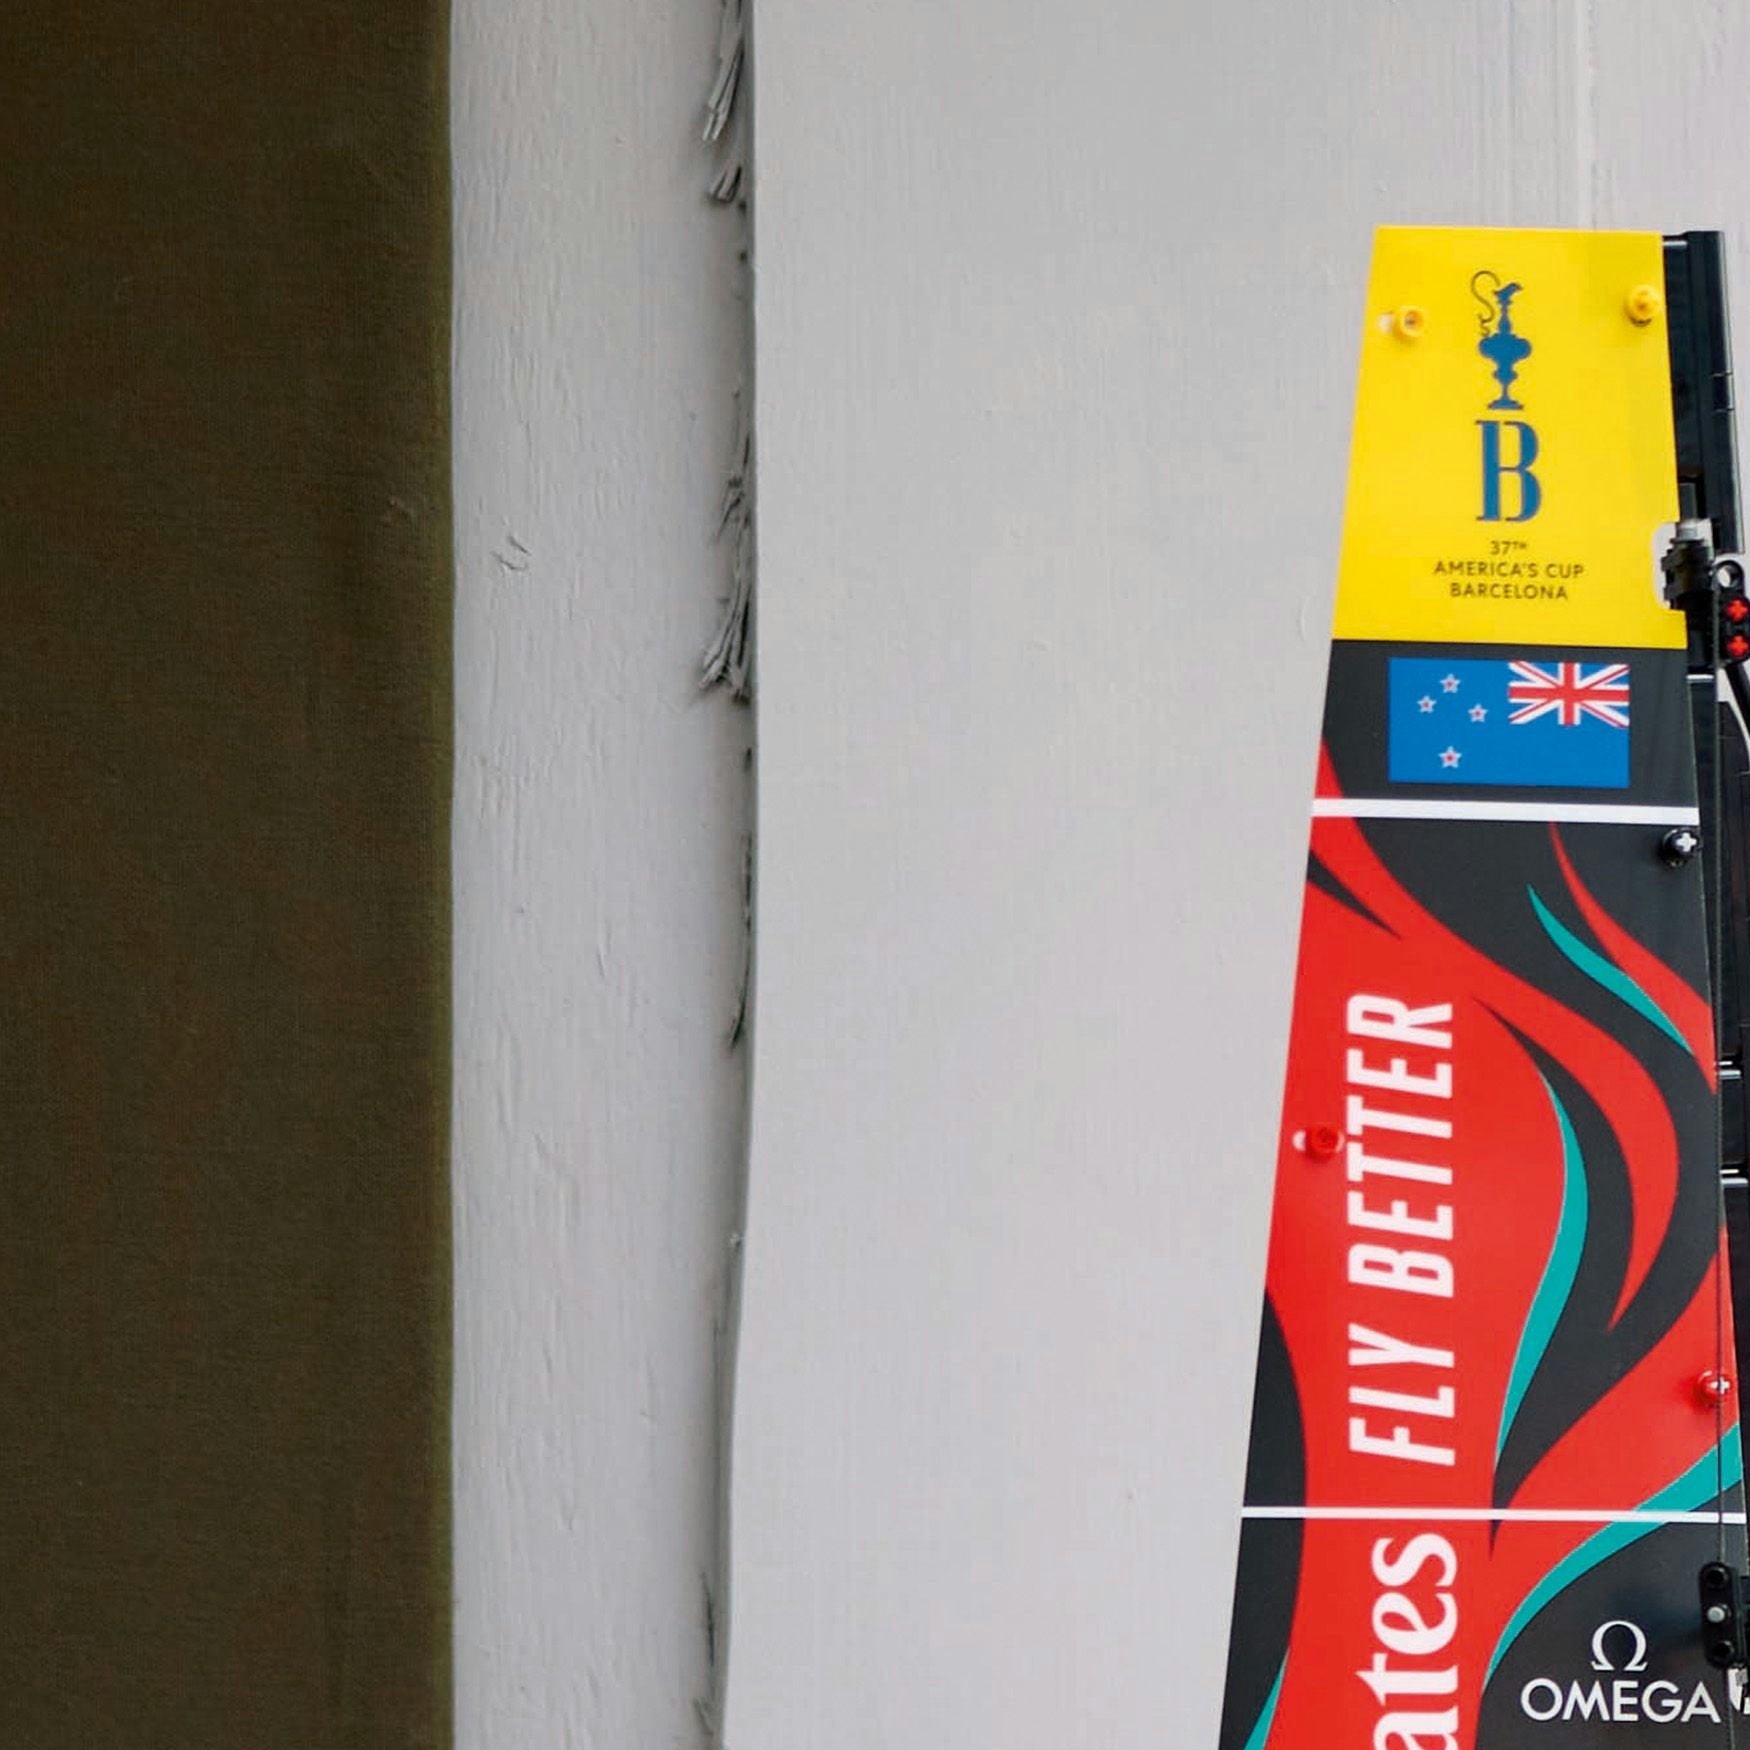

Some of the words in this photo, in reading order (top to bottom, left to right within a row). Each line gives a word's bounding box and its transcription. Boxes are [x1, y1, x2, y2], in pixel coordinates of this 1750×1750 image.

[1474, 419, 1542, 521] B
[1434, 560, 1538, 579] AMERICA'S
[1545, 563, 1584, 579] CUP
[1450, 582, 1568, 600] BARCELONA
[1346, 994, 1454, 1298] BETTER
[1348, 1323, 1455, 1466] FLY
[1520, 1677, 1721, 1723] OMEGA
